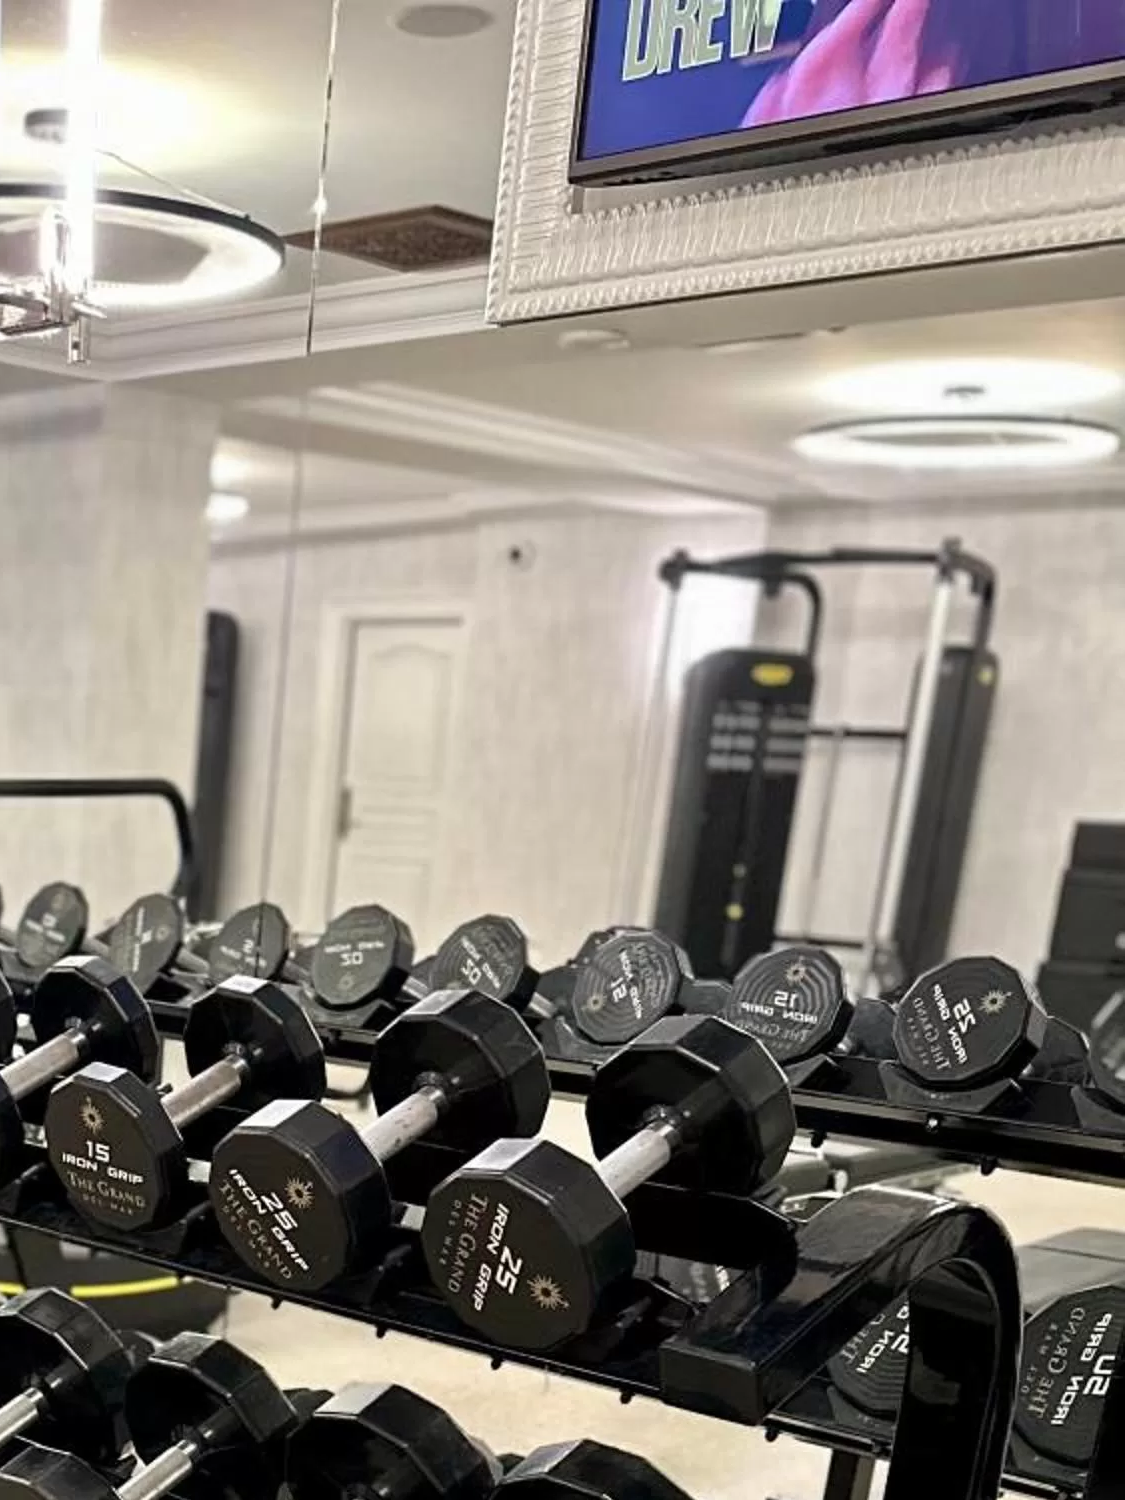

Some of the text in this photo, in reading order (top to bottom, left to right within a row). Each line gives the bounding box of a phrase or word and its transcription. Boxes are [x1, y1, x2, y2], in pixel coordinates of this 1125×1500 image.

[622, 0, 782, 82] DREW
[62, 1152, 144, 1185] IRON GRIP
[85, 1140, 110, 1164] 15
[67, 1171, 147, 1208] THE GRAND
[228, 1168, 310, 1272] IRON GRIP
[260, 1191, 299, 1231] 25
[219, 1181, 294, 1280] THE GRAND
[447, 1192, 490, 1294] THE GRAND
[472, 1202, 511, 1312] IRON GRIP
[494, 1244, 524, 1295] 25
